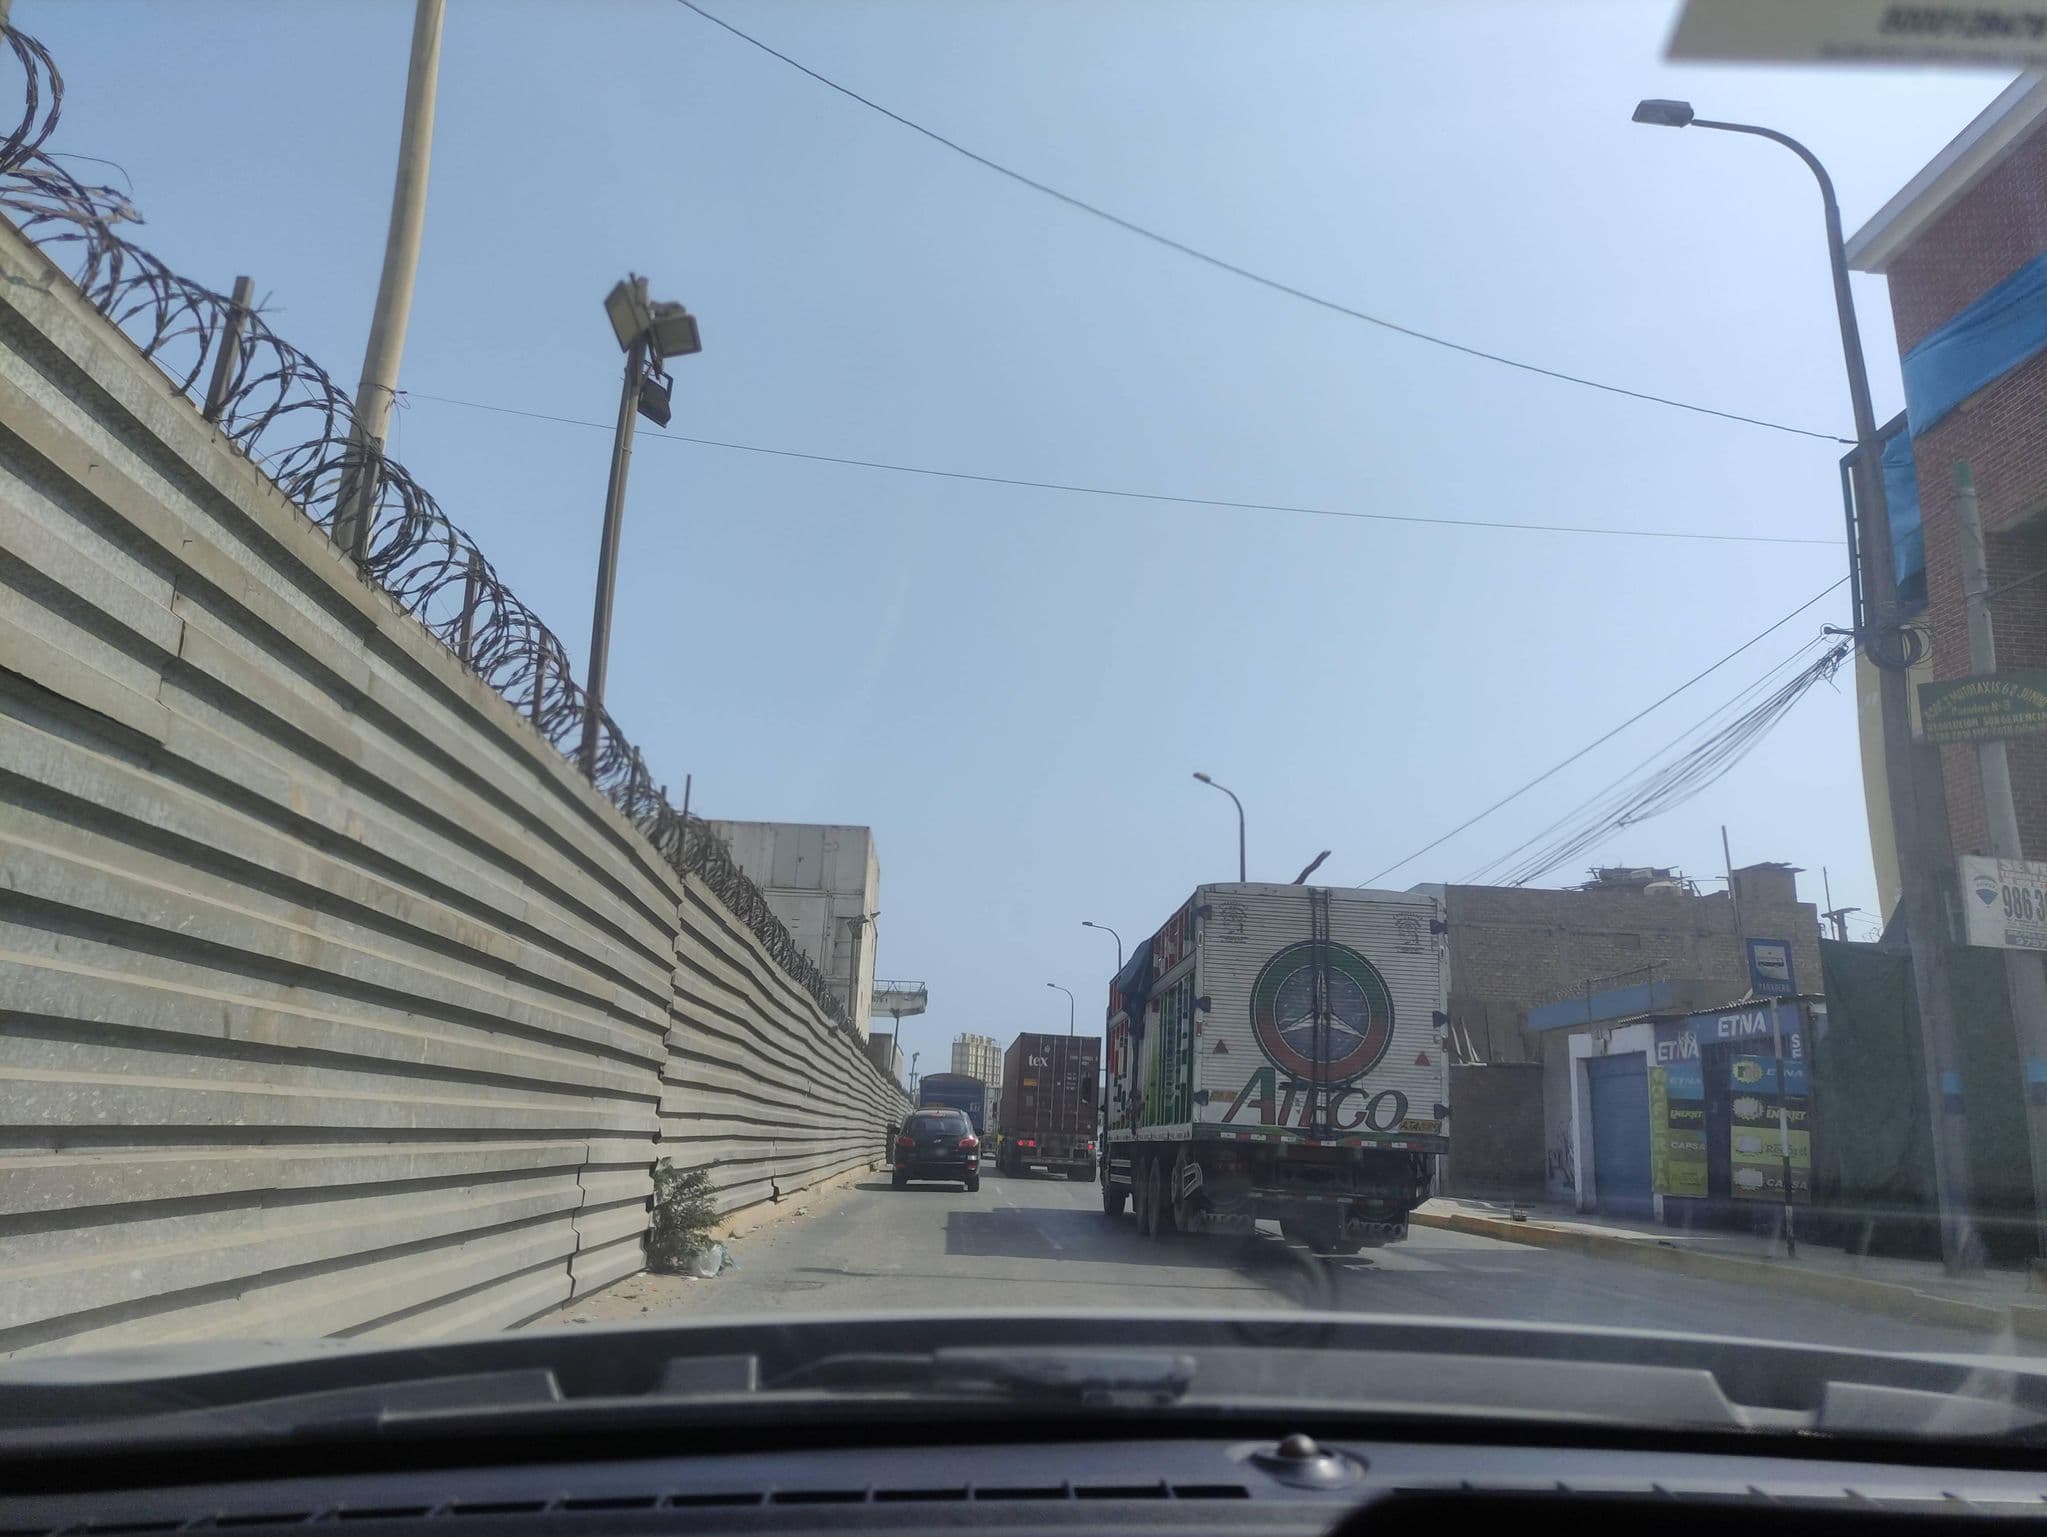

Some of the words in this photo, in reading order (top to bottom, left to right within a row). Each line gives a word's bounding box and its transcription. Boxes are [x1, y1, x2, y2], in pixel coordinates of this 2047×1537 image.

[2002, 884, 2034, 921] 986
[1717, 1011, 1767, 1038] ETNA
[1658, 1039, 1700, 1062] ETNA
[1028, 1054, 1049, 1067] tex
[1766, 1069, 1804, 1079] ENA
[1671, 1141, 1706, 1152] CAPSA
[1766, 1178, 1809, 1190] CASA
